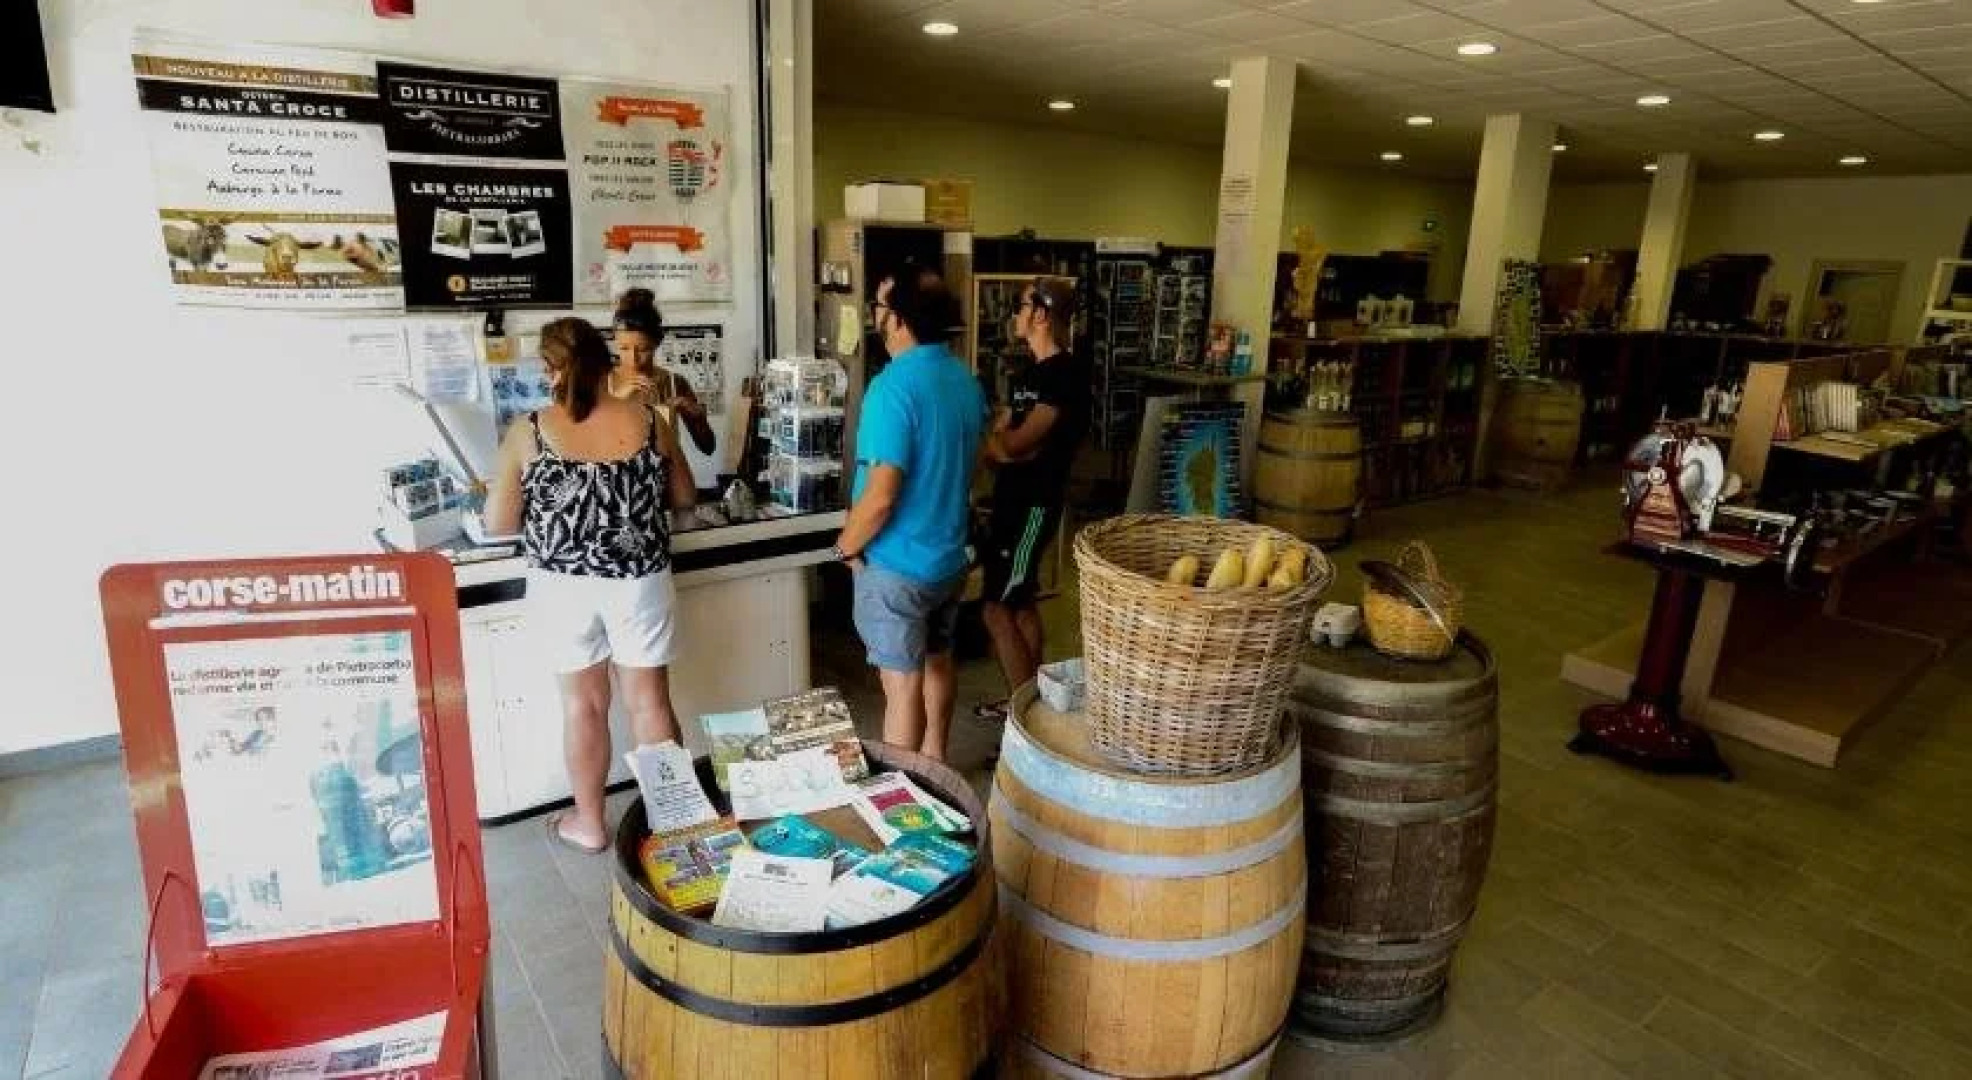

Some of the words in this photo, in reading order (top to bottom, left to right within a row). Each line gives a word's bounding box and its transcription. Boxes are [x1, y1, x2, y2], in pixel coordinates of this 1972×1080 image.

[180, 95, 261, 114] SANTA
[270, 102, 348, 119] CROCE
[400, 86, 541, 109] DISTILLERIE
[410, 181, 446, 195] LES
[453, 183, 554, 198] CHAMBRES
[162, 565, 401, 609] corse-matin
[316, 661, 335, 674] de
[330, 673, 399, 687] commune
